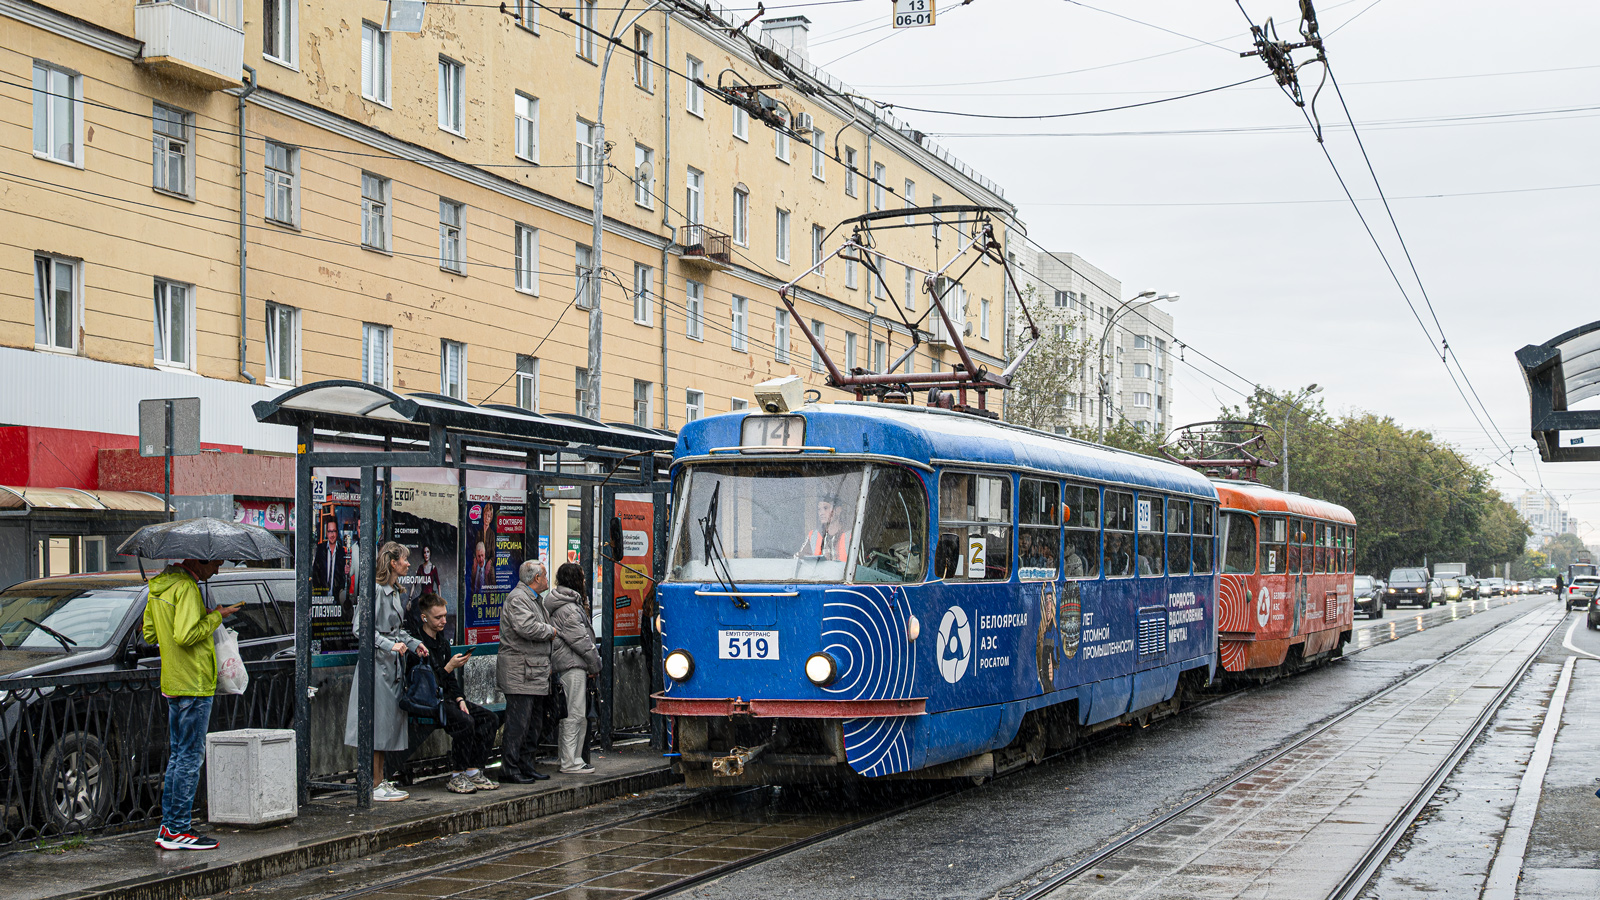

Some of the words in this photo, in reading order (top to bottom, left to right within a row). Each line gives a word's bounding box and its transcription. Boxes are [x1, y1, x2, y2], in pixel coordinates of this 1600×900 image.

[908, 0, 925, 11] 13
[896, 13, 931, 26] 06-01
[758, 417, 791, 446] 14
[314, 480, 324, 494] 23
[394, 487, 415, 501] СВОЙ
[1139, 503, 1149, 521] 519
[498, 518, 502, 526] 8
[503, 518, 523, 526] ОКТЯБРЯ
[496, 541, 523, 550] ЧУРСИНА
[496, 557, 509, 567] ДИК
[471, 593, 488, 608] ДВА
[1168, 591, 1196, 609] ГОРДОСТЬ
[312, 605, 342, 618] ГЛАЗУНОВ
[477, 607, 483, 619] В
[485, 606, 501, 618] МИЛ
[1168, 607, 1204, 627] ВДОХНОВЕНИЕ
[980, 613, 1028, 630] БЕЛОЯРСКАЯ
[1082, 612, 1094, 626] ЛЕТ
[1082, 623, 1110, 643] АТОМНОЙ
[1168, 627, 1188, 644] МЕЧТА!
[728, 637, 769, 658] 519
[980, 635, 998, 650] АЭС
[1082, 639, 1135, 660] ПРОМЫШЛЕННОСТИ
[980, 656, 1010, 669] РОСАТОМ
